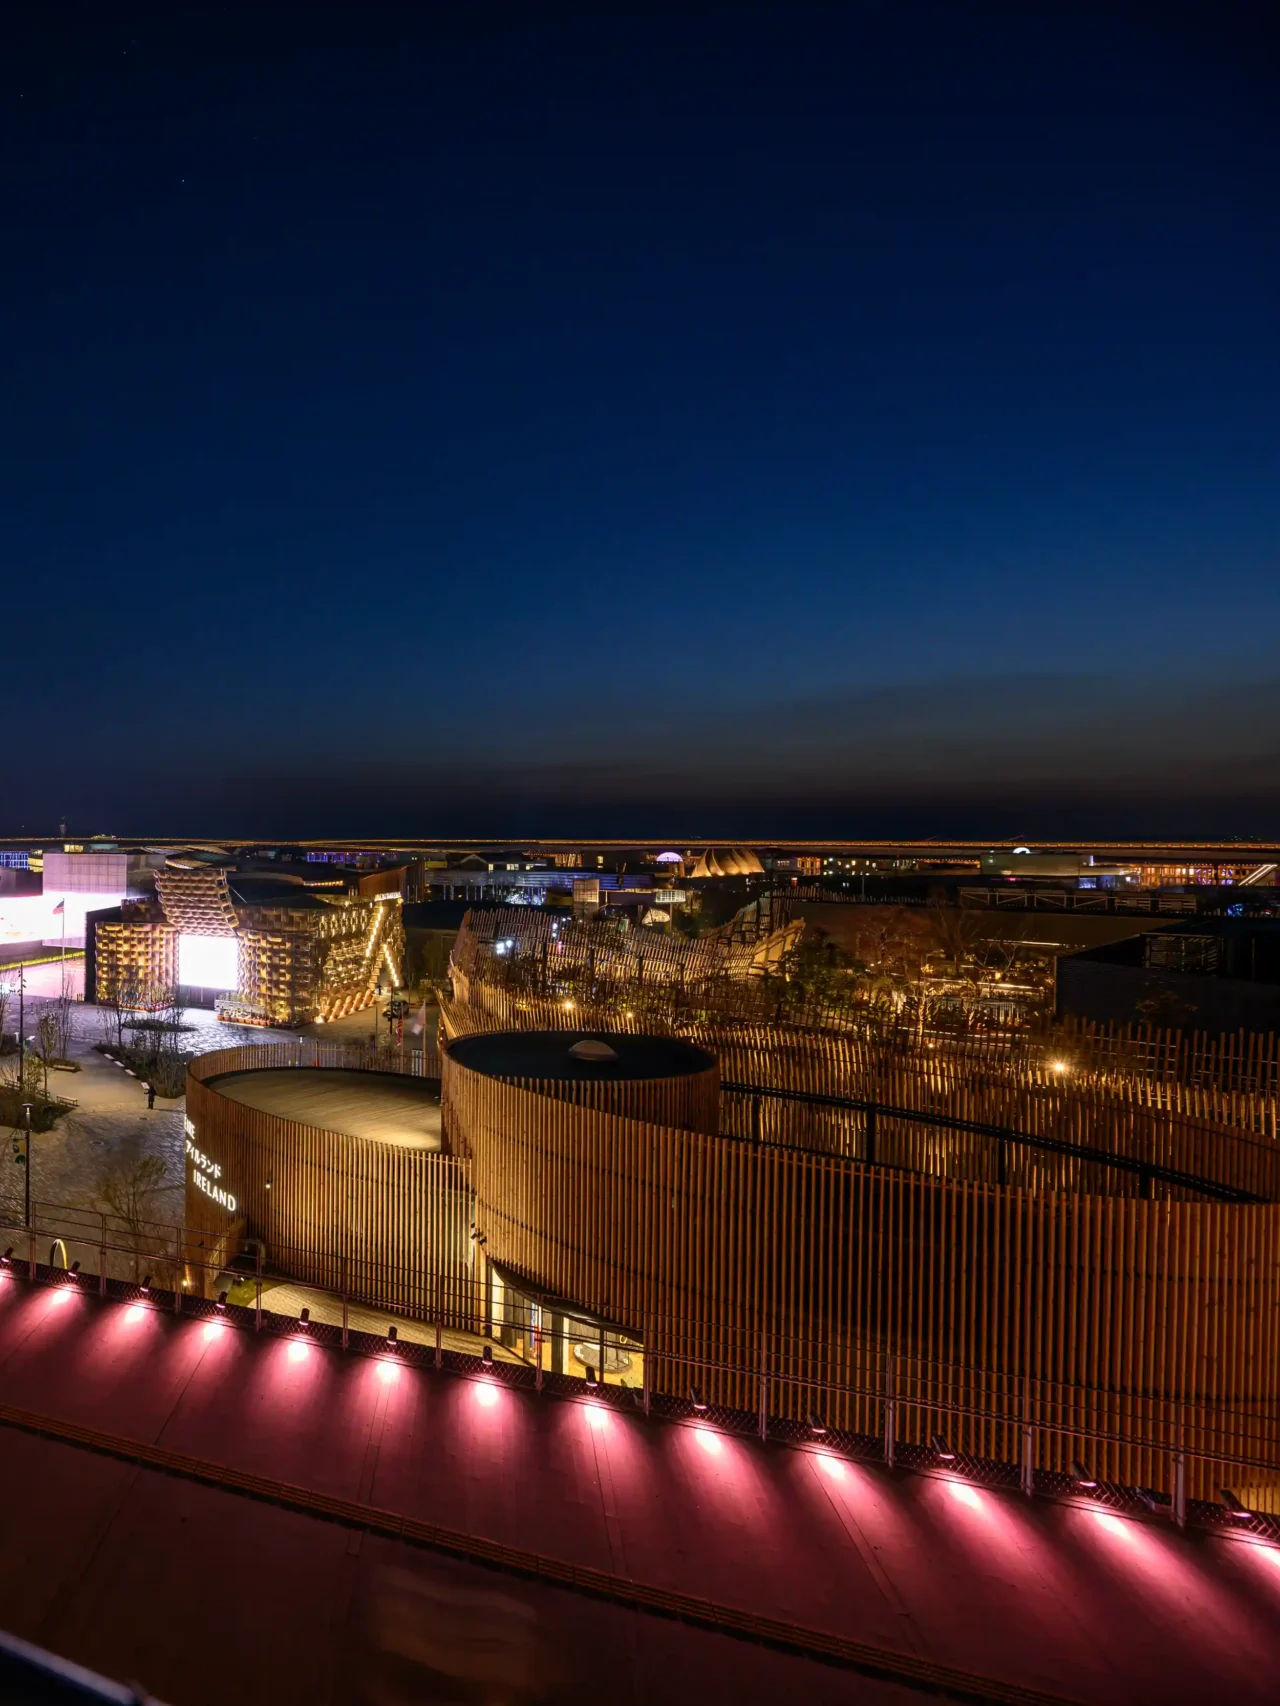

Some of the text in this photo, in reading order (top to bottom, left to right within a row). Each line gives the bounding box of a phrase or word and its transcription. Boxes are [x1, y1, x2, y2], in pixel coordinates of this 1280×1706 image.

[185, 1139, 222, 1178] アイルランド
[193, 1169, 236, 1211] IRELAND
